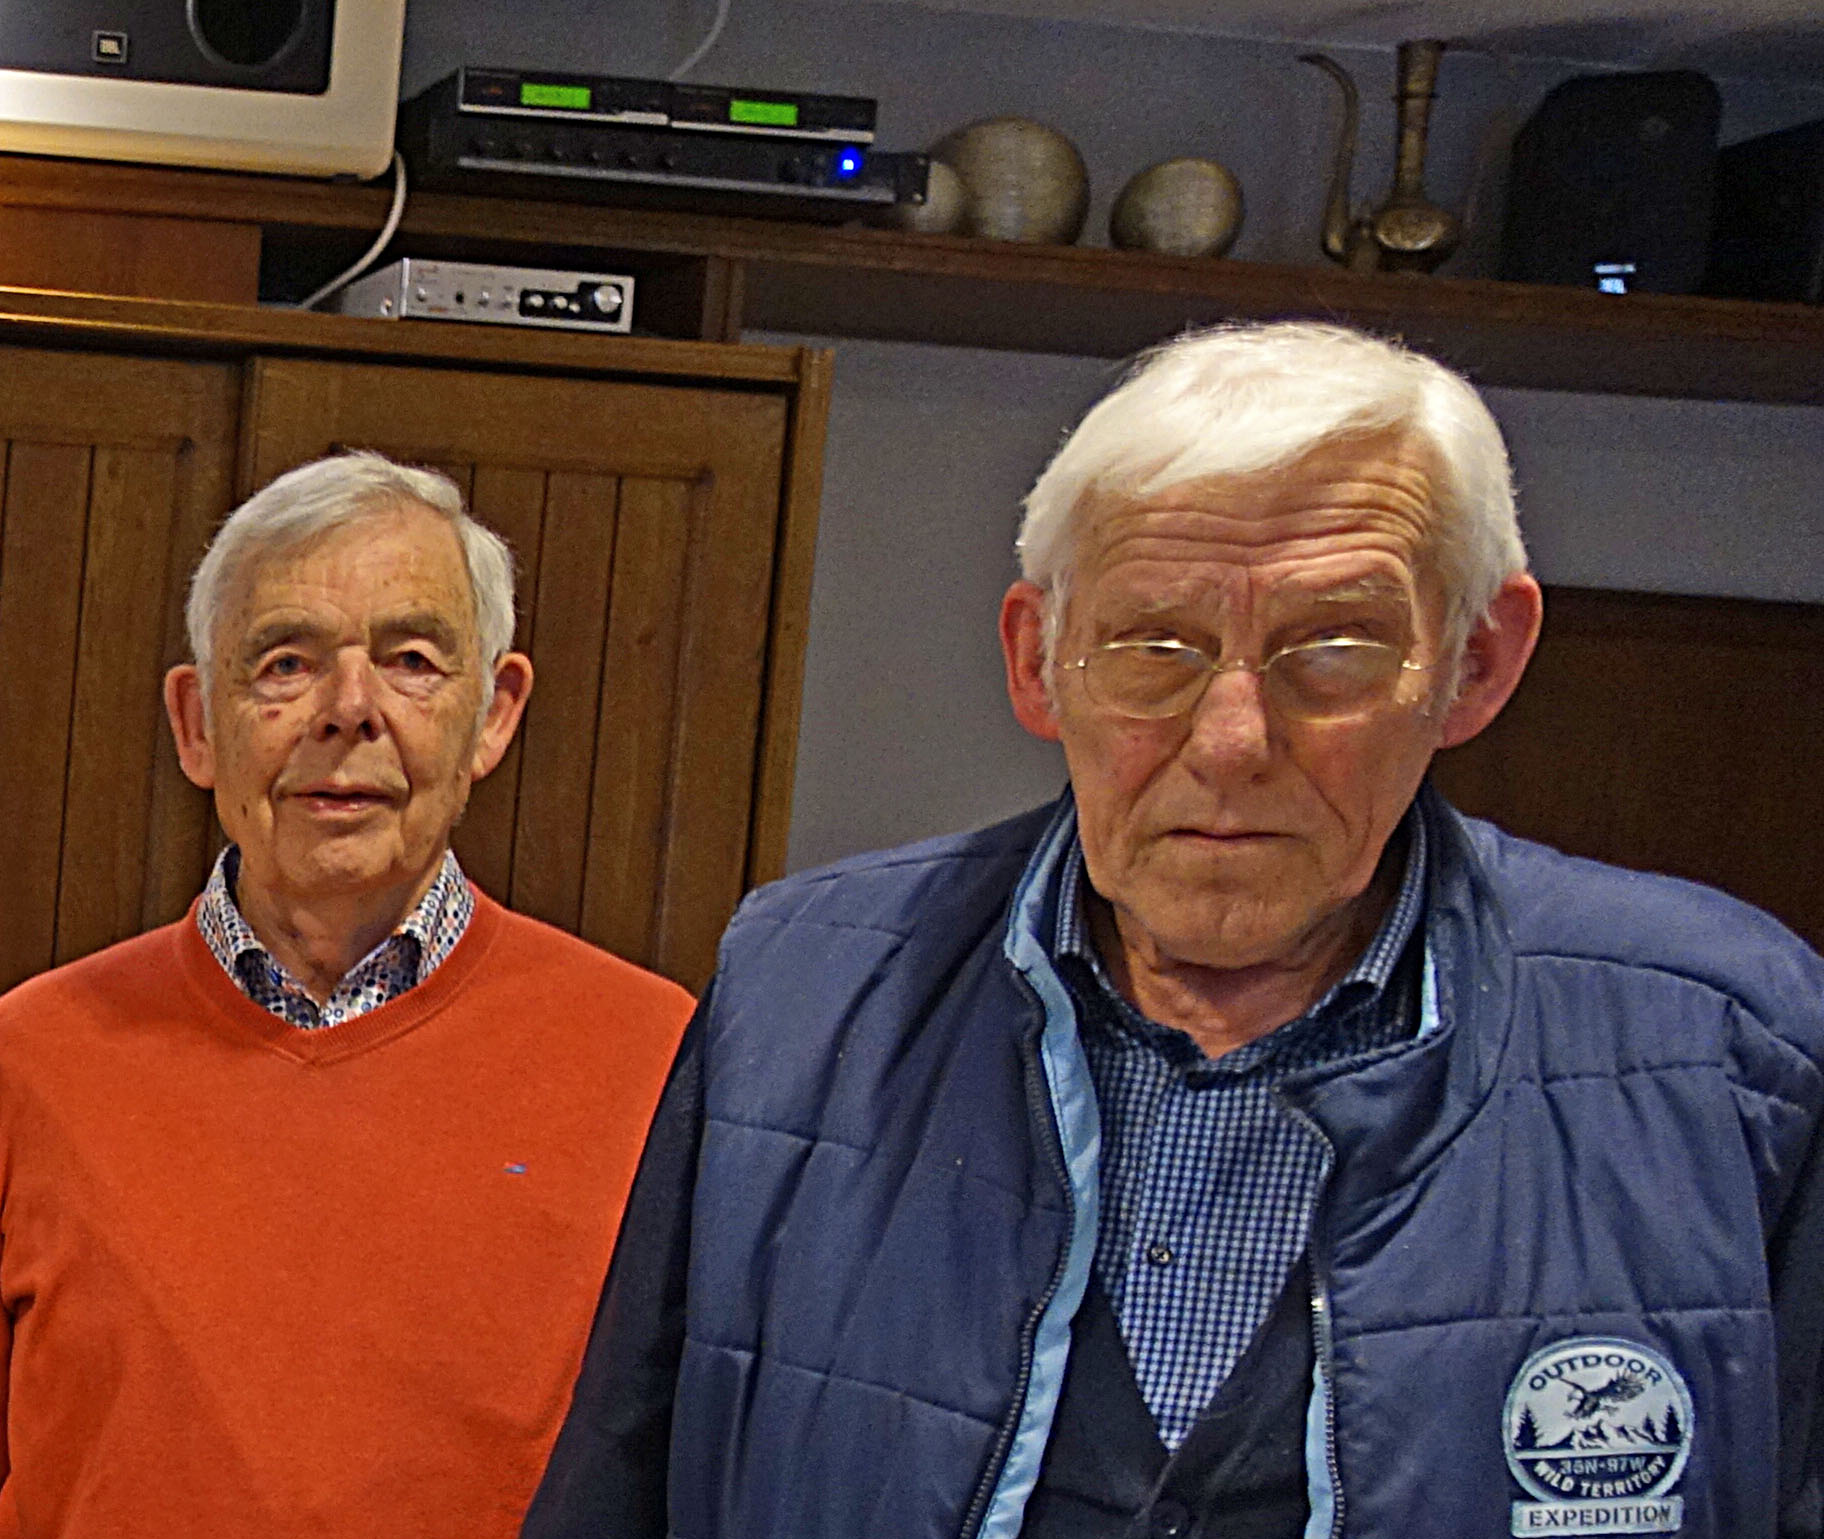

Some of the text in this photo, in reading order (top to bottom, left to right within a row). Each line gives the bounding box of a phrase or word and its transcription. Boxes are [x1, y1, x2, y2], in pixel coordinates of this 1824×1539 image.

[1529, 1354, 1663, 1391] OUTDOOR
[1534, 1455, 1666, 1498] WILD TERRITORY
[1529, 1504, 1671, 1527] EXPEDITION
